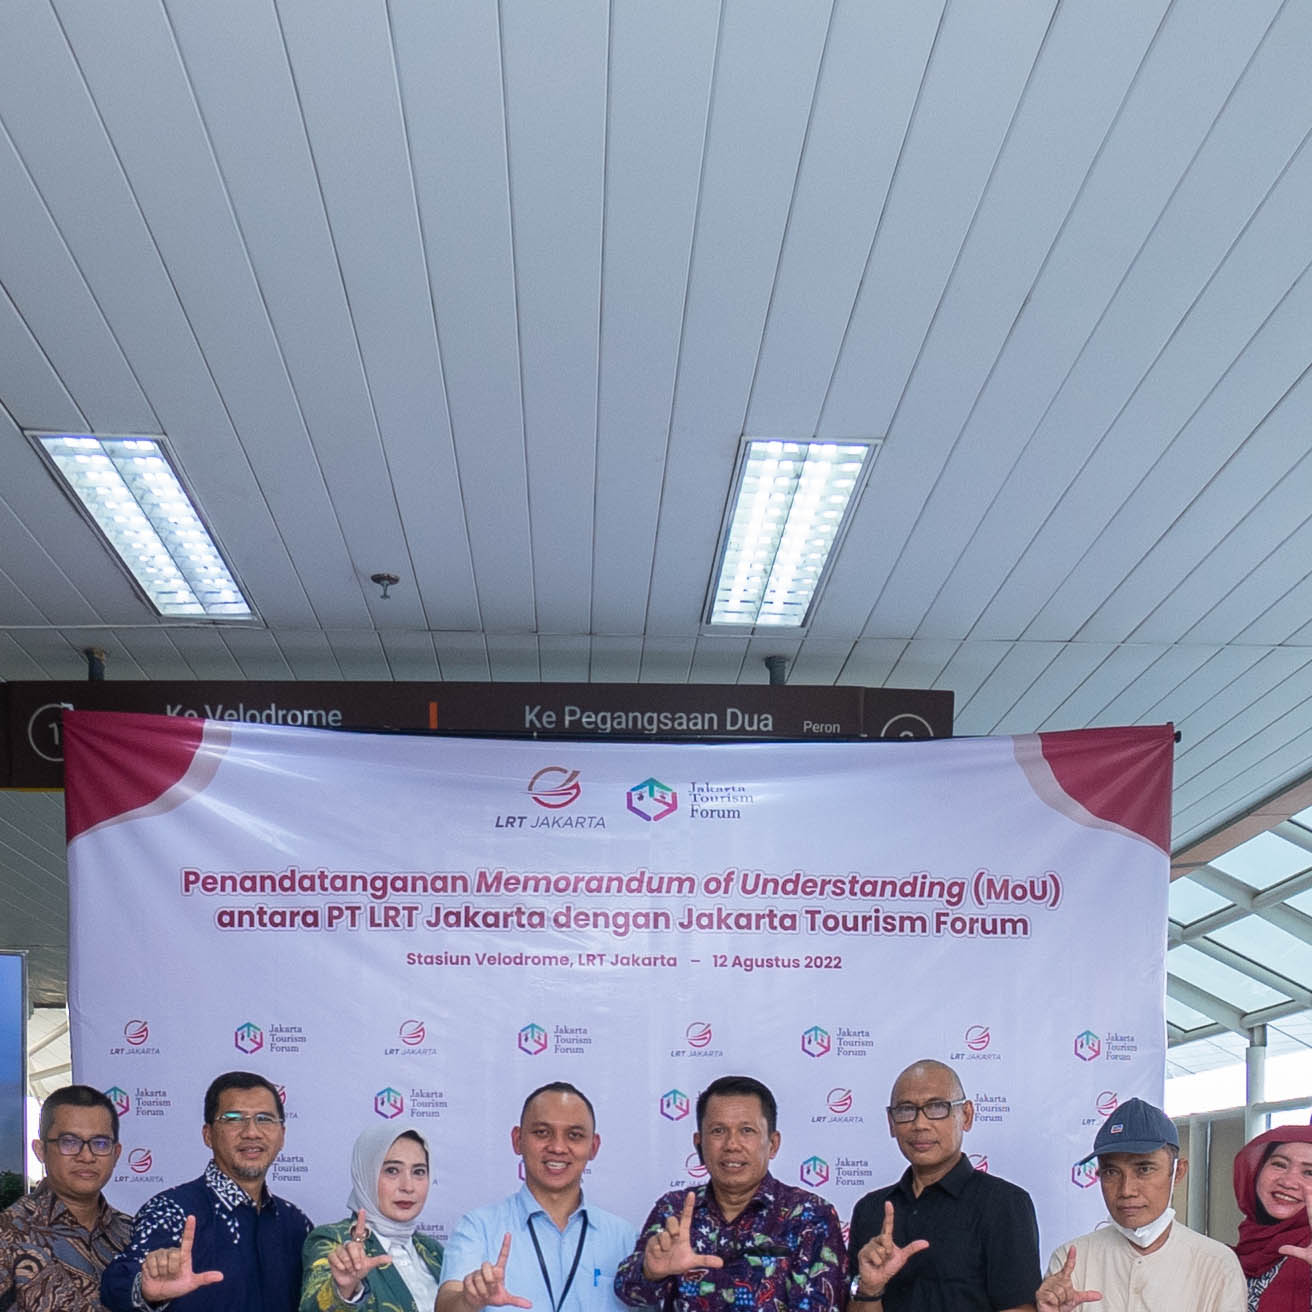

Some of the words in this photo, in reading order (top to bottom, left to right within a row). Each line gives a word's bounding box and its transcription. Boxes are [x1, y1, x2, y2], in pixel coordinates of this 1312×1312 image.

[524, 705, 557, 729] Ke
[565, 705, 718, 734] Pegangsaan
[726, 708, 774, 733] Dua
[803, 719, 841, 735] Peron
[688, 781, 747, 794] Jakarta
[688, 792, 754, 805] Tourism
[689, 804, 742, 820] Forum
[495, 814, 528, 829] LRT
[530, 814, 607, 830] JAKARTA
[183, 868, 469, 900] Penandatanganan
[475, 870, 696, 896] Memorandum
[703, 870, 738, 896] of
[740, 872, 966, 907] Understanding
[973, 871, 1062, 908] (MoU)
[217, 907, 319, 929] antara
[327, 905, 361, 928] PT
[369, 905, 419, 928] LRT
[426, 905, 546, 929] Jakarta
[553, 906, 671, 937] dengan
[677, 908, 799, 933] Jakarta
[805, 909, 928, 934] Tourism
[935, 911, 1029, 936] Forum
[406, 951, 471, 967] Stasiun
[475, 951, 574, 970] Velodrome,
[578, 952, 605, 967] LRT
[609, 952, 678, 968] Jakarta
[712, 953, 728, 968] 12
[732, 953, 801, 972] Agustus
[804, 954, 843, 970] 2022
[268, 1023, 303, 1033] Jakarta
[553, 1024, 588, 1035] Jakarta
[835, 1027, 870, 1037] Jakarta
[269, 1033, 307, 1043] Tourism
[553, 1035, 593, 1045] Tourism
[836, 1037, 874, 1047] Tourism
[1104, 1032, 1135, 1042] Jakarta
[125, 1047, 161, 1055] JAKARTA
[269, 1043, 300, 1053] Forum
[384, 1048, 399, 1056] LRT
[400, 1048, 437, 1056] JAKARTA
[553, 1044, 585, 1054] Forum
[836, 1047, 867, 1057] Forum
[1105, 1042, 1138, 1052] Tourism
[670, 1050, 686, 1058] LRT
[687, 1050, 723, 1058] JAKARTA
[966, 1053, 1001, 1061] JAKARTA
[1105, 1051, 1131, 1061] Forum
[134, 1087, 167, 1097] Jakarta
[409, 1088, 444, 1099] Jakarta
[134, 1097, 172, 1107] Tourism
[974, 1093, 1007, 1103] Jakarta
[409, 1098, 448, 1109] Tourism
[974, 1103, 1011, 1113] Tourism
[135, 1107, 165, 1116] Forum
[410, 1108, 441, 1118] Forum
[810, 1115, 827, 1123] LRT
[827, 1115, 864, 1123] JAKARTA
[975, 1112, 1003, 1122] Forum
[276, 1153, 305, 1163] akarta
[835, 1157, 869, 1167] Jakarta
[272, 1163, 309, 1173] Tourism
[835, 1167, 873, 1177] Tourism
[130, 1175, 165, 1183] JAKARTA
[272, 1172, 302, 1182] Forum
[835, 1176, 865, 1186] Forum
[415, 1223, 445, 1232] akarta
